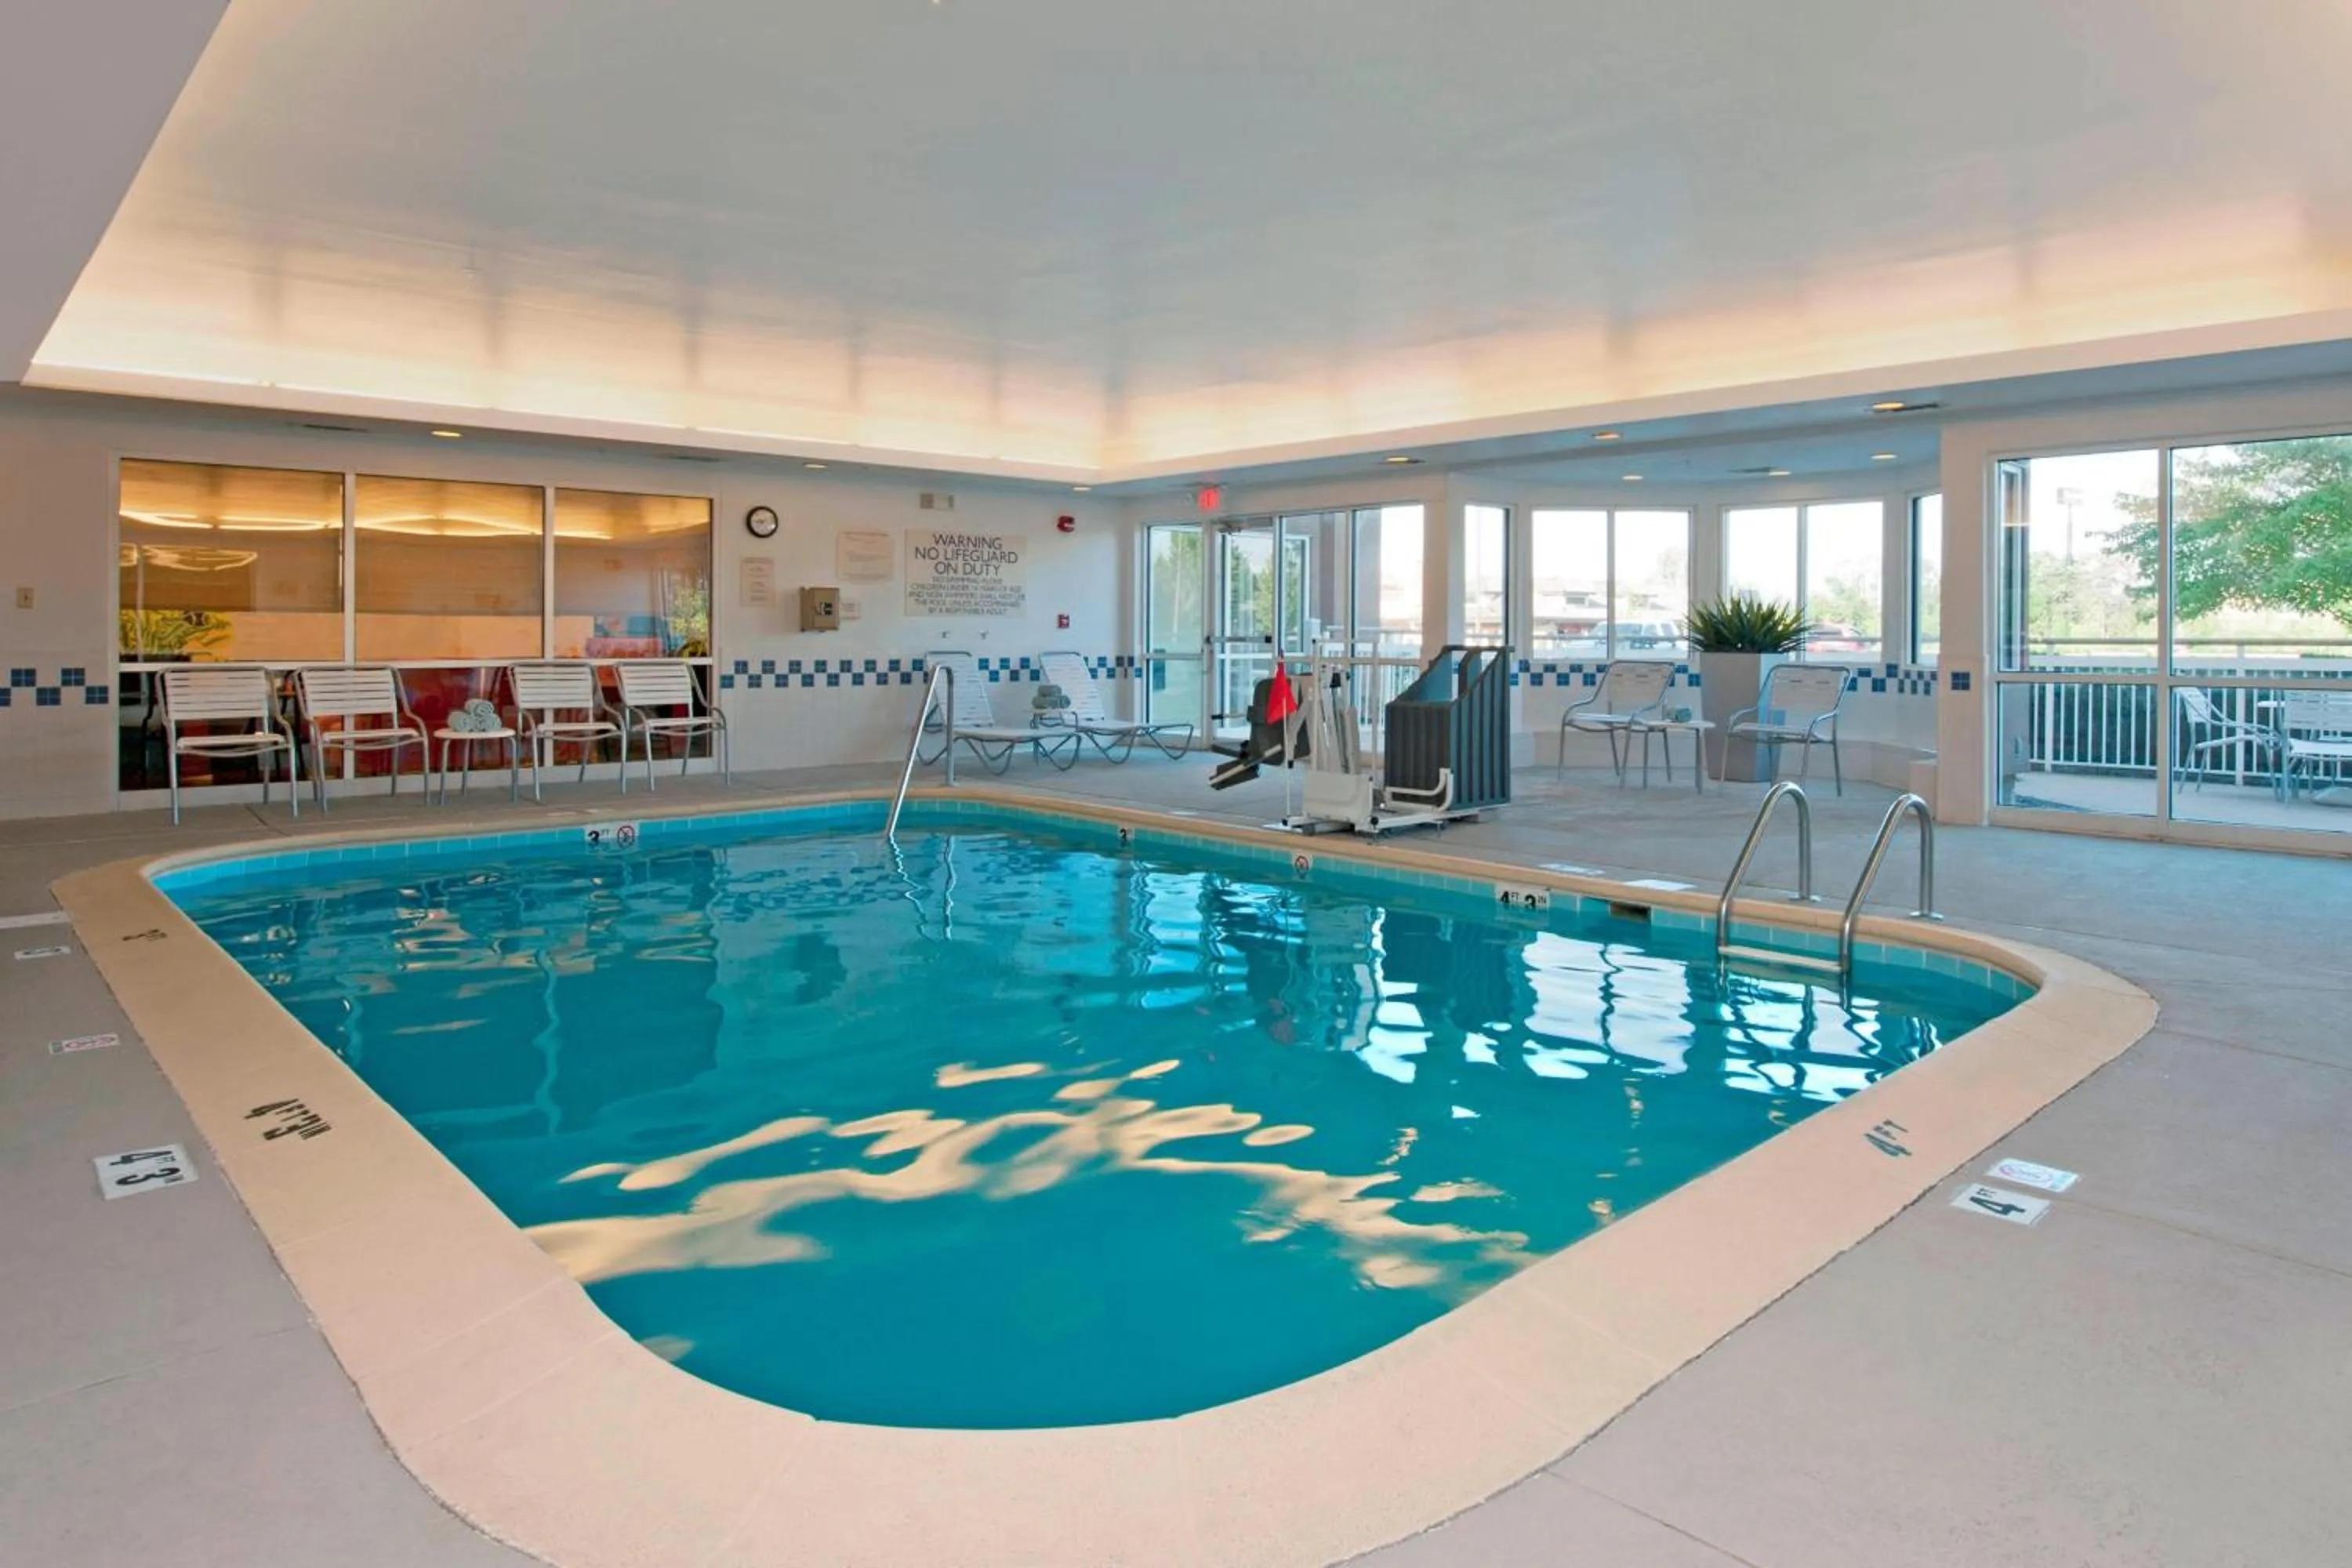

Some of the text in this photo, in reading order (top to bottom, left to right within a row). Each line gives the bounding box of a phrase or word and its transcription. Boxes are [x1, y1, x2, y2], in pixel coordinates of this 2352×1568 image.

[933, 533, 1003, 550] WARNING
[915, 547, 1018, 564] NO LIFEGUARD
[935, 561, 1000, 576] ON DUTY
